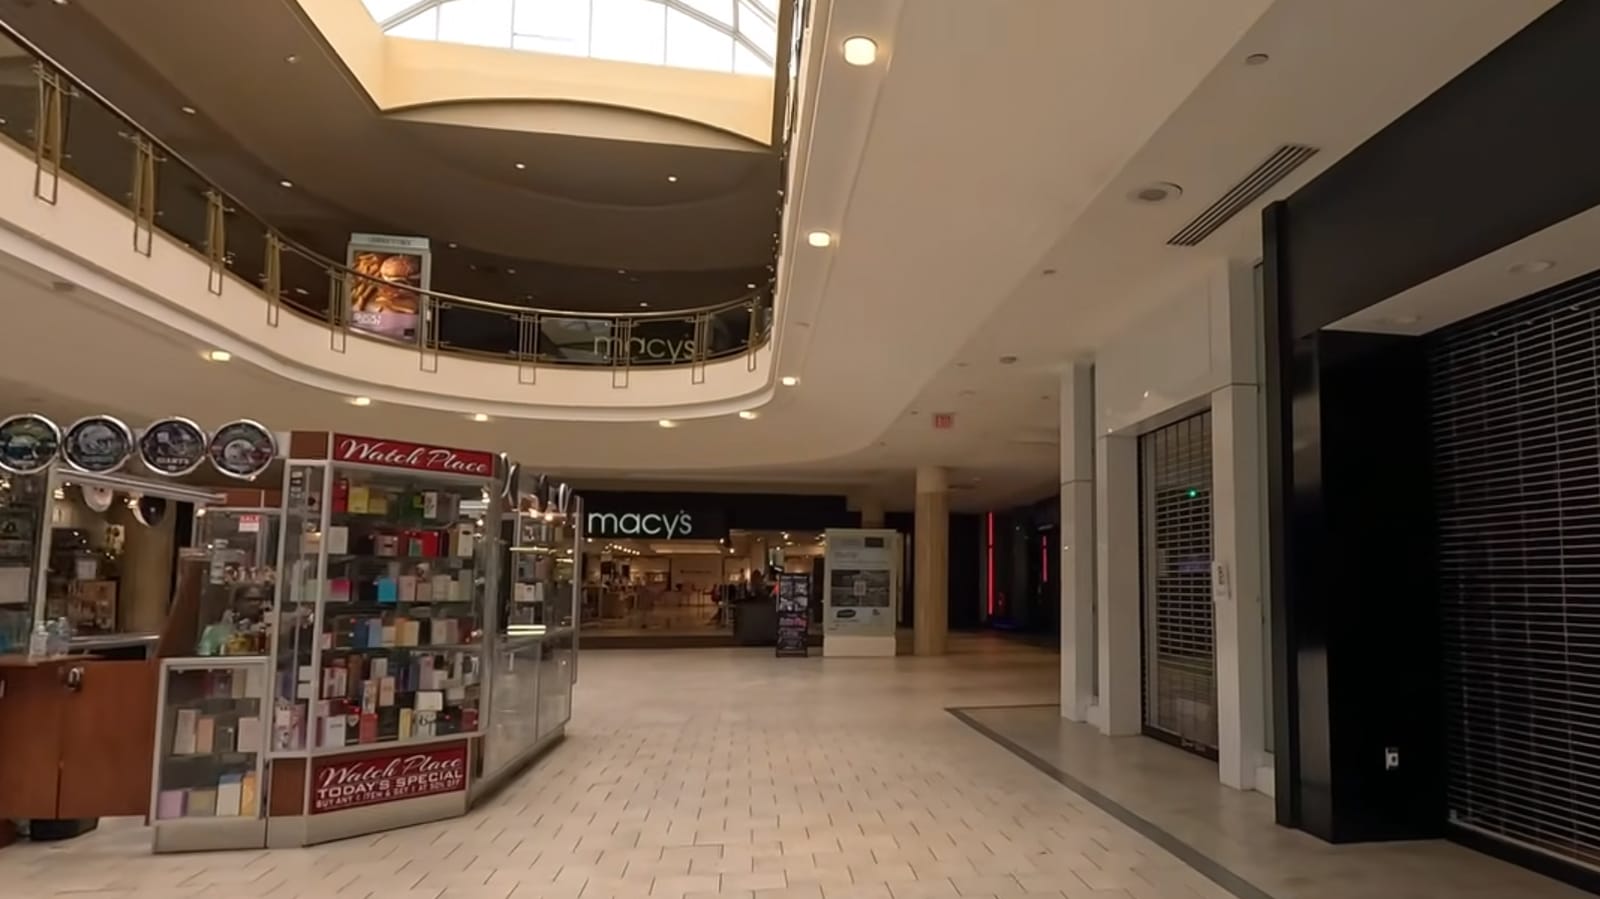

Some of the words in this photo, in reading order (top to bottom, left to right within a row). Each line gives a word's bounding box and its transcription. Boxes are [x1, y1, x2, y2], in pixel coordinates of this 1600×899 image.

[340, 439, 425, 465] Watch
[427, 450, 487, 472] Place
[588, 509, 692, 540] macy's
[317, 780, 390, 799] TODAY'S
[396, 770, 464, 787] SPECIAL
[319, 758, 402, 788] Watch
[402, 754, 462, 775] Place
[316, 798, 334, 808] BUY
[336, 795, 353, 804] ANY
[419, 783, 427, 791] AT
